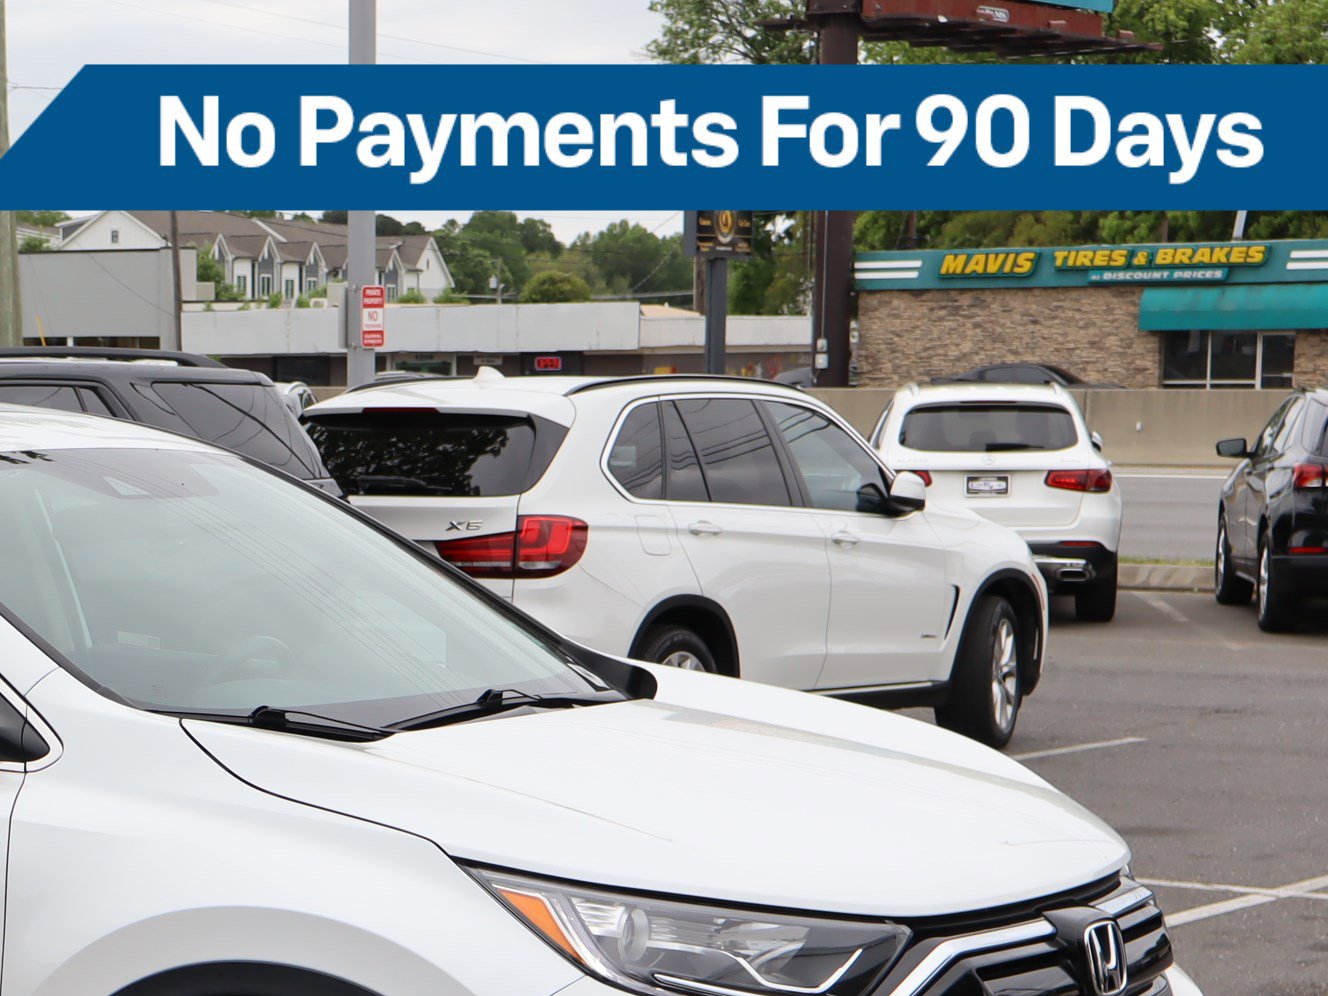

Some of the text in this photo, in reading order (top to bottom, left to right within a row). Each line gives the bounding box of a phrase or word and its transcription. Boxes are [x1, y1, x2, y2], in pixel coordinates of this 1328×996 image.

[940, 246, 1266, 275] MAVIS TIRES & BRAKES
[1103, 271, 1169, 280] DISCOUNT
[1173, 270, 1222, 279] PRICES
[368, 310, 378, 321] NO
